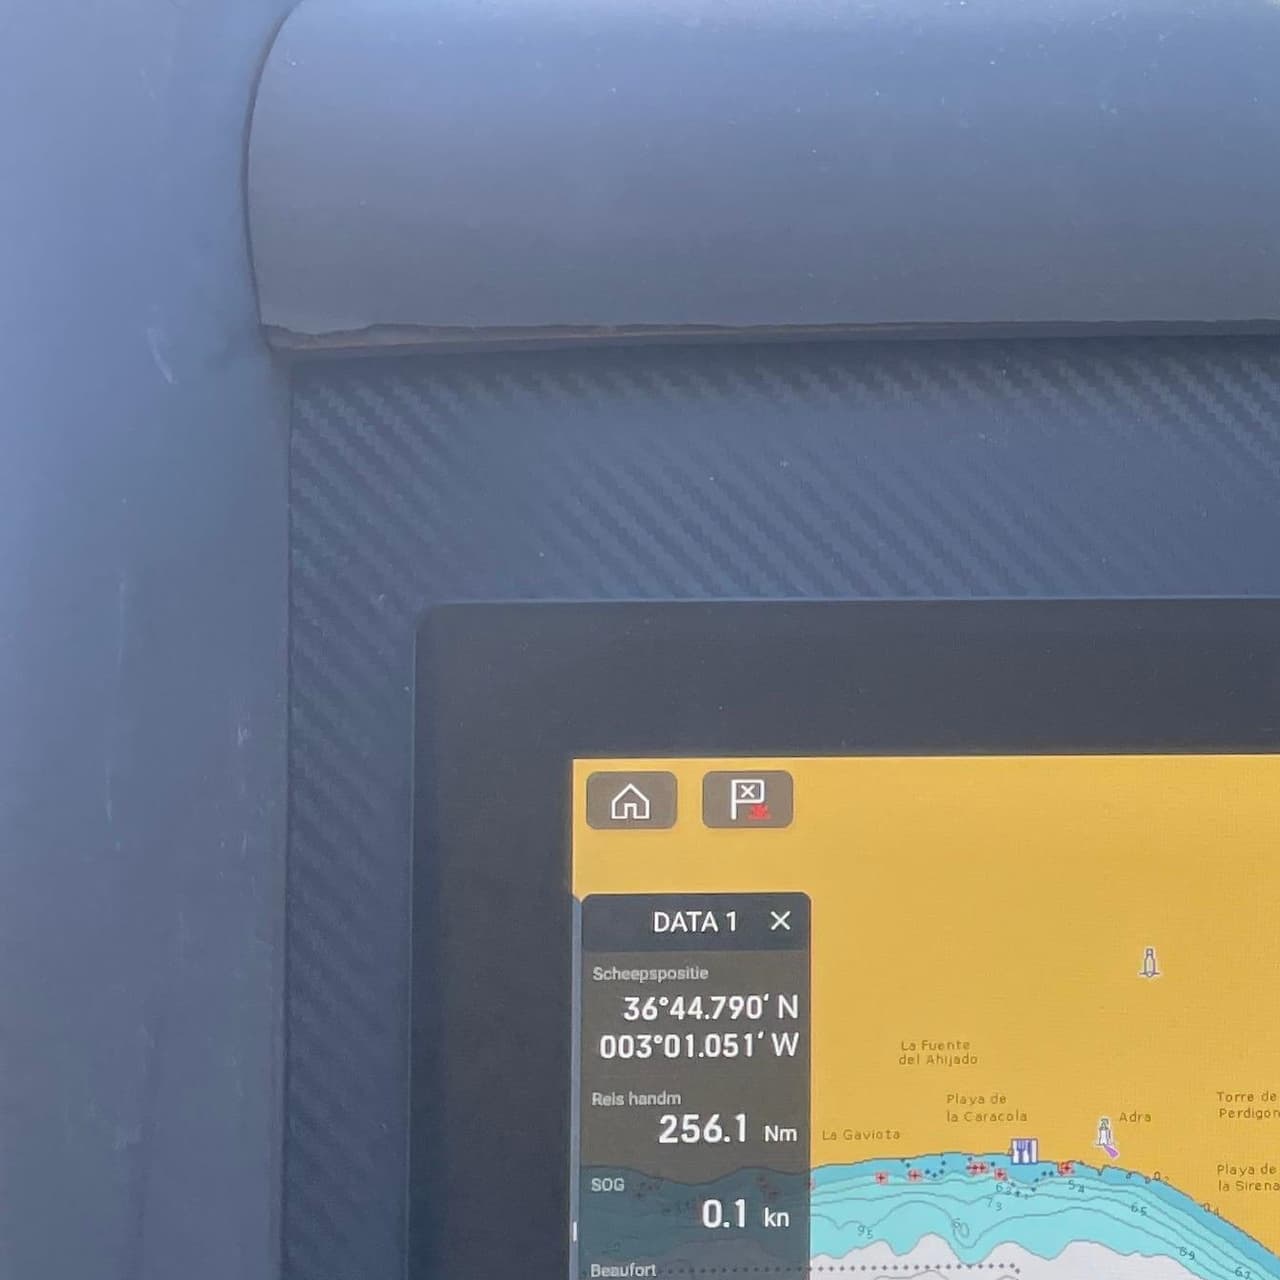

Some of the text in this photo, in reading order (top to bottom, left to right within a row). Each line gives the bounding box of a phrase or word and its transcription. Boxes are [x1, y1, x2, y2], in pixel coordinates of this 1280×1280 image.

[653, 911, 737, 932] DATA 1
[592, 966, 709, 984] Scheepspositie
[777, 994, 799, 1020] N
[771, 1032, 800, 1057] W
[591, 1090, 682, 1106] Reis handm
[658, 1113, 798, 1144] 256.1 Nm
[591, 1177, 625, 1192] SOG
[702, 1199, 790, 1229] 0.1 kn
[590, 1261, 657, 1278] Beaufort
